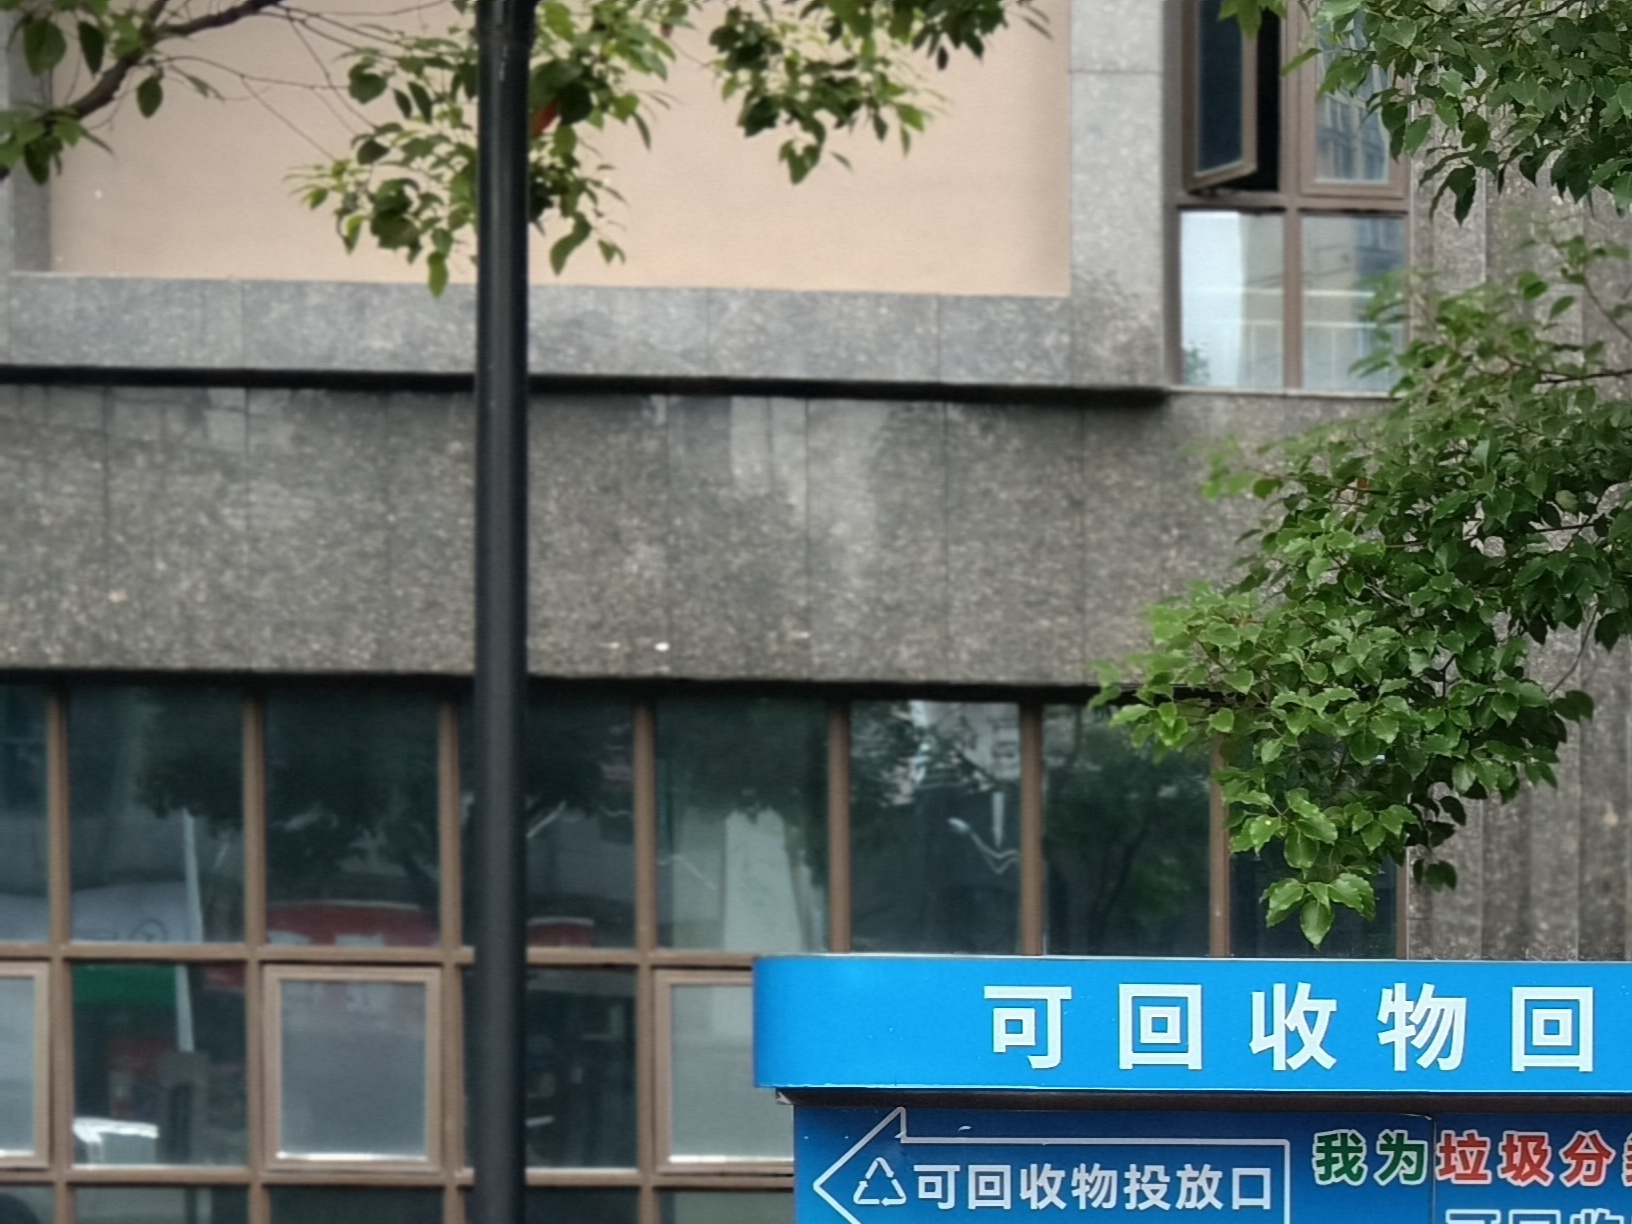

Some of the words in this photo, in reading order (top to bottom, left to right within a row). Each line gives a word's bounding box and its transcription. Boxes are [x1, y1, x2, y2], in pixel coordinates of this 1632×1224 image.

[914, 1162, 1272, 1211] 可回收物投放口
